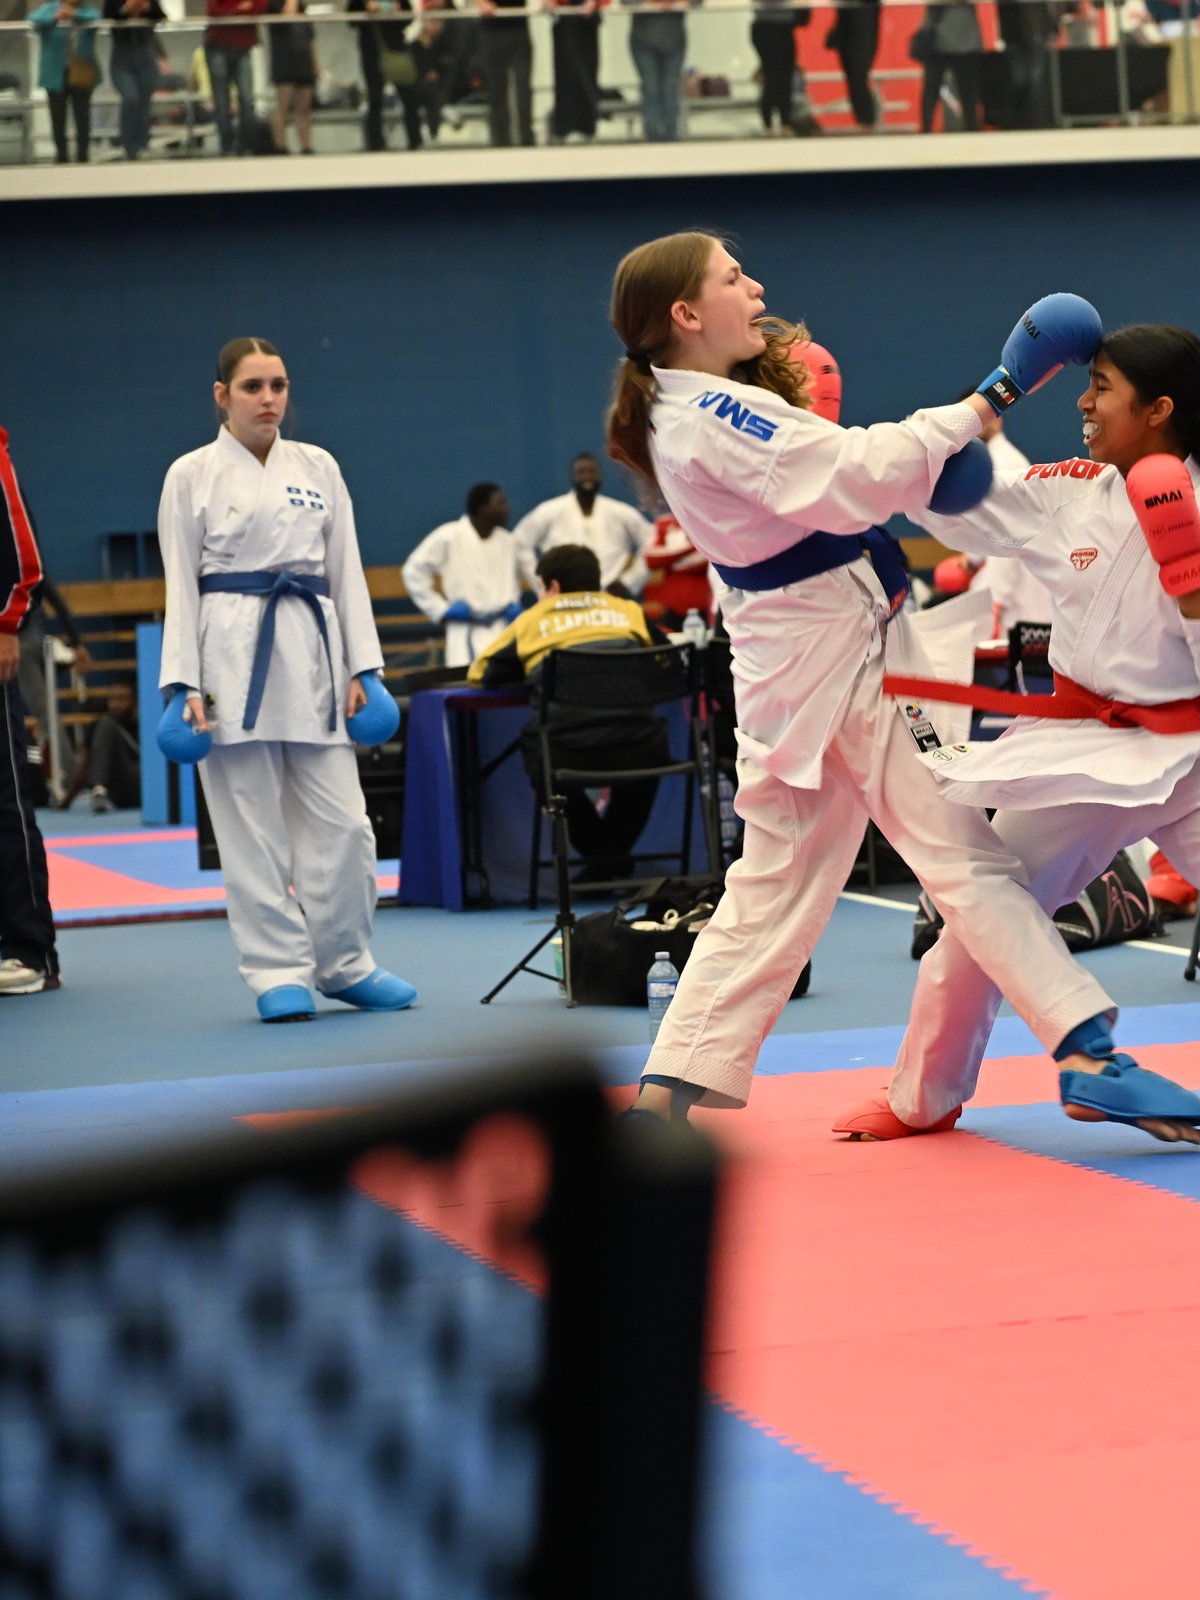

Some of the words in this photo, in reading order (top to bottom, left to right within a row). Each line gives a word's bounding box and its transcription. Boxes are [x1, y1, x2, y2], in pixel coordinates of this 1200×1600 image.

[992, 381, 1016, 405] SMAI
[689, 390, 779, 442] SMA
[1144, 489, 1184, 510] SMAI
